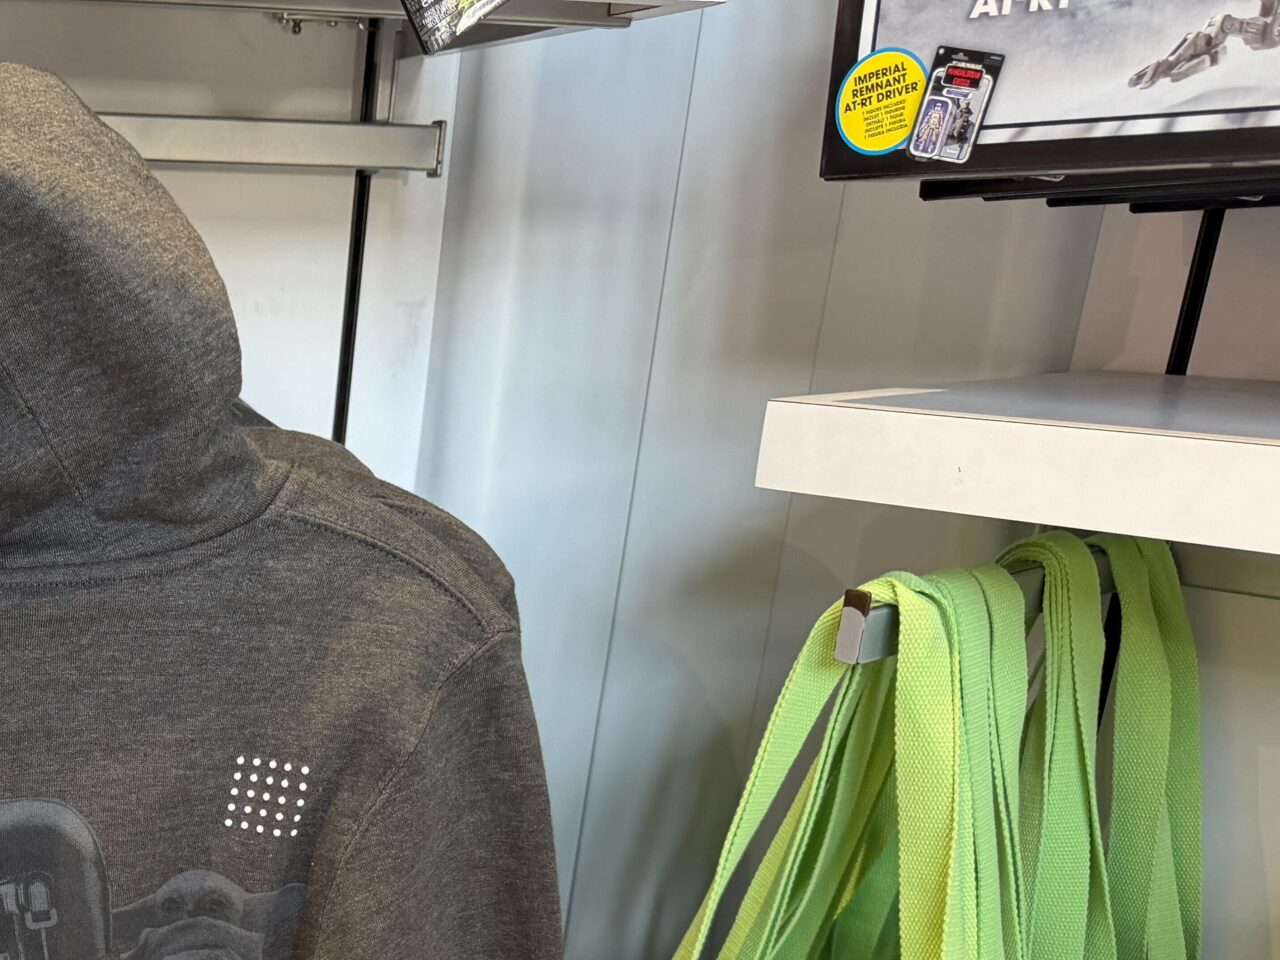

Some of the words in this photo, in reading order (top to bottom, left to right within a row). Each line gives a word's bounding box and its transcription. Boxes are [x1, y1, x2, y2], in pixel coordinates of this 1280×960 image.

[852, 73, 907, 99] REMNANT
[853, 62, 907, 87] IMPERIAL
[844, 95, 873, 113] AT-RT
[877, 82, 919, 103] DRIVER
